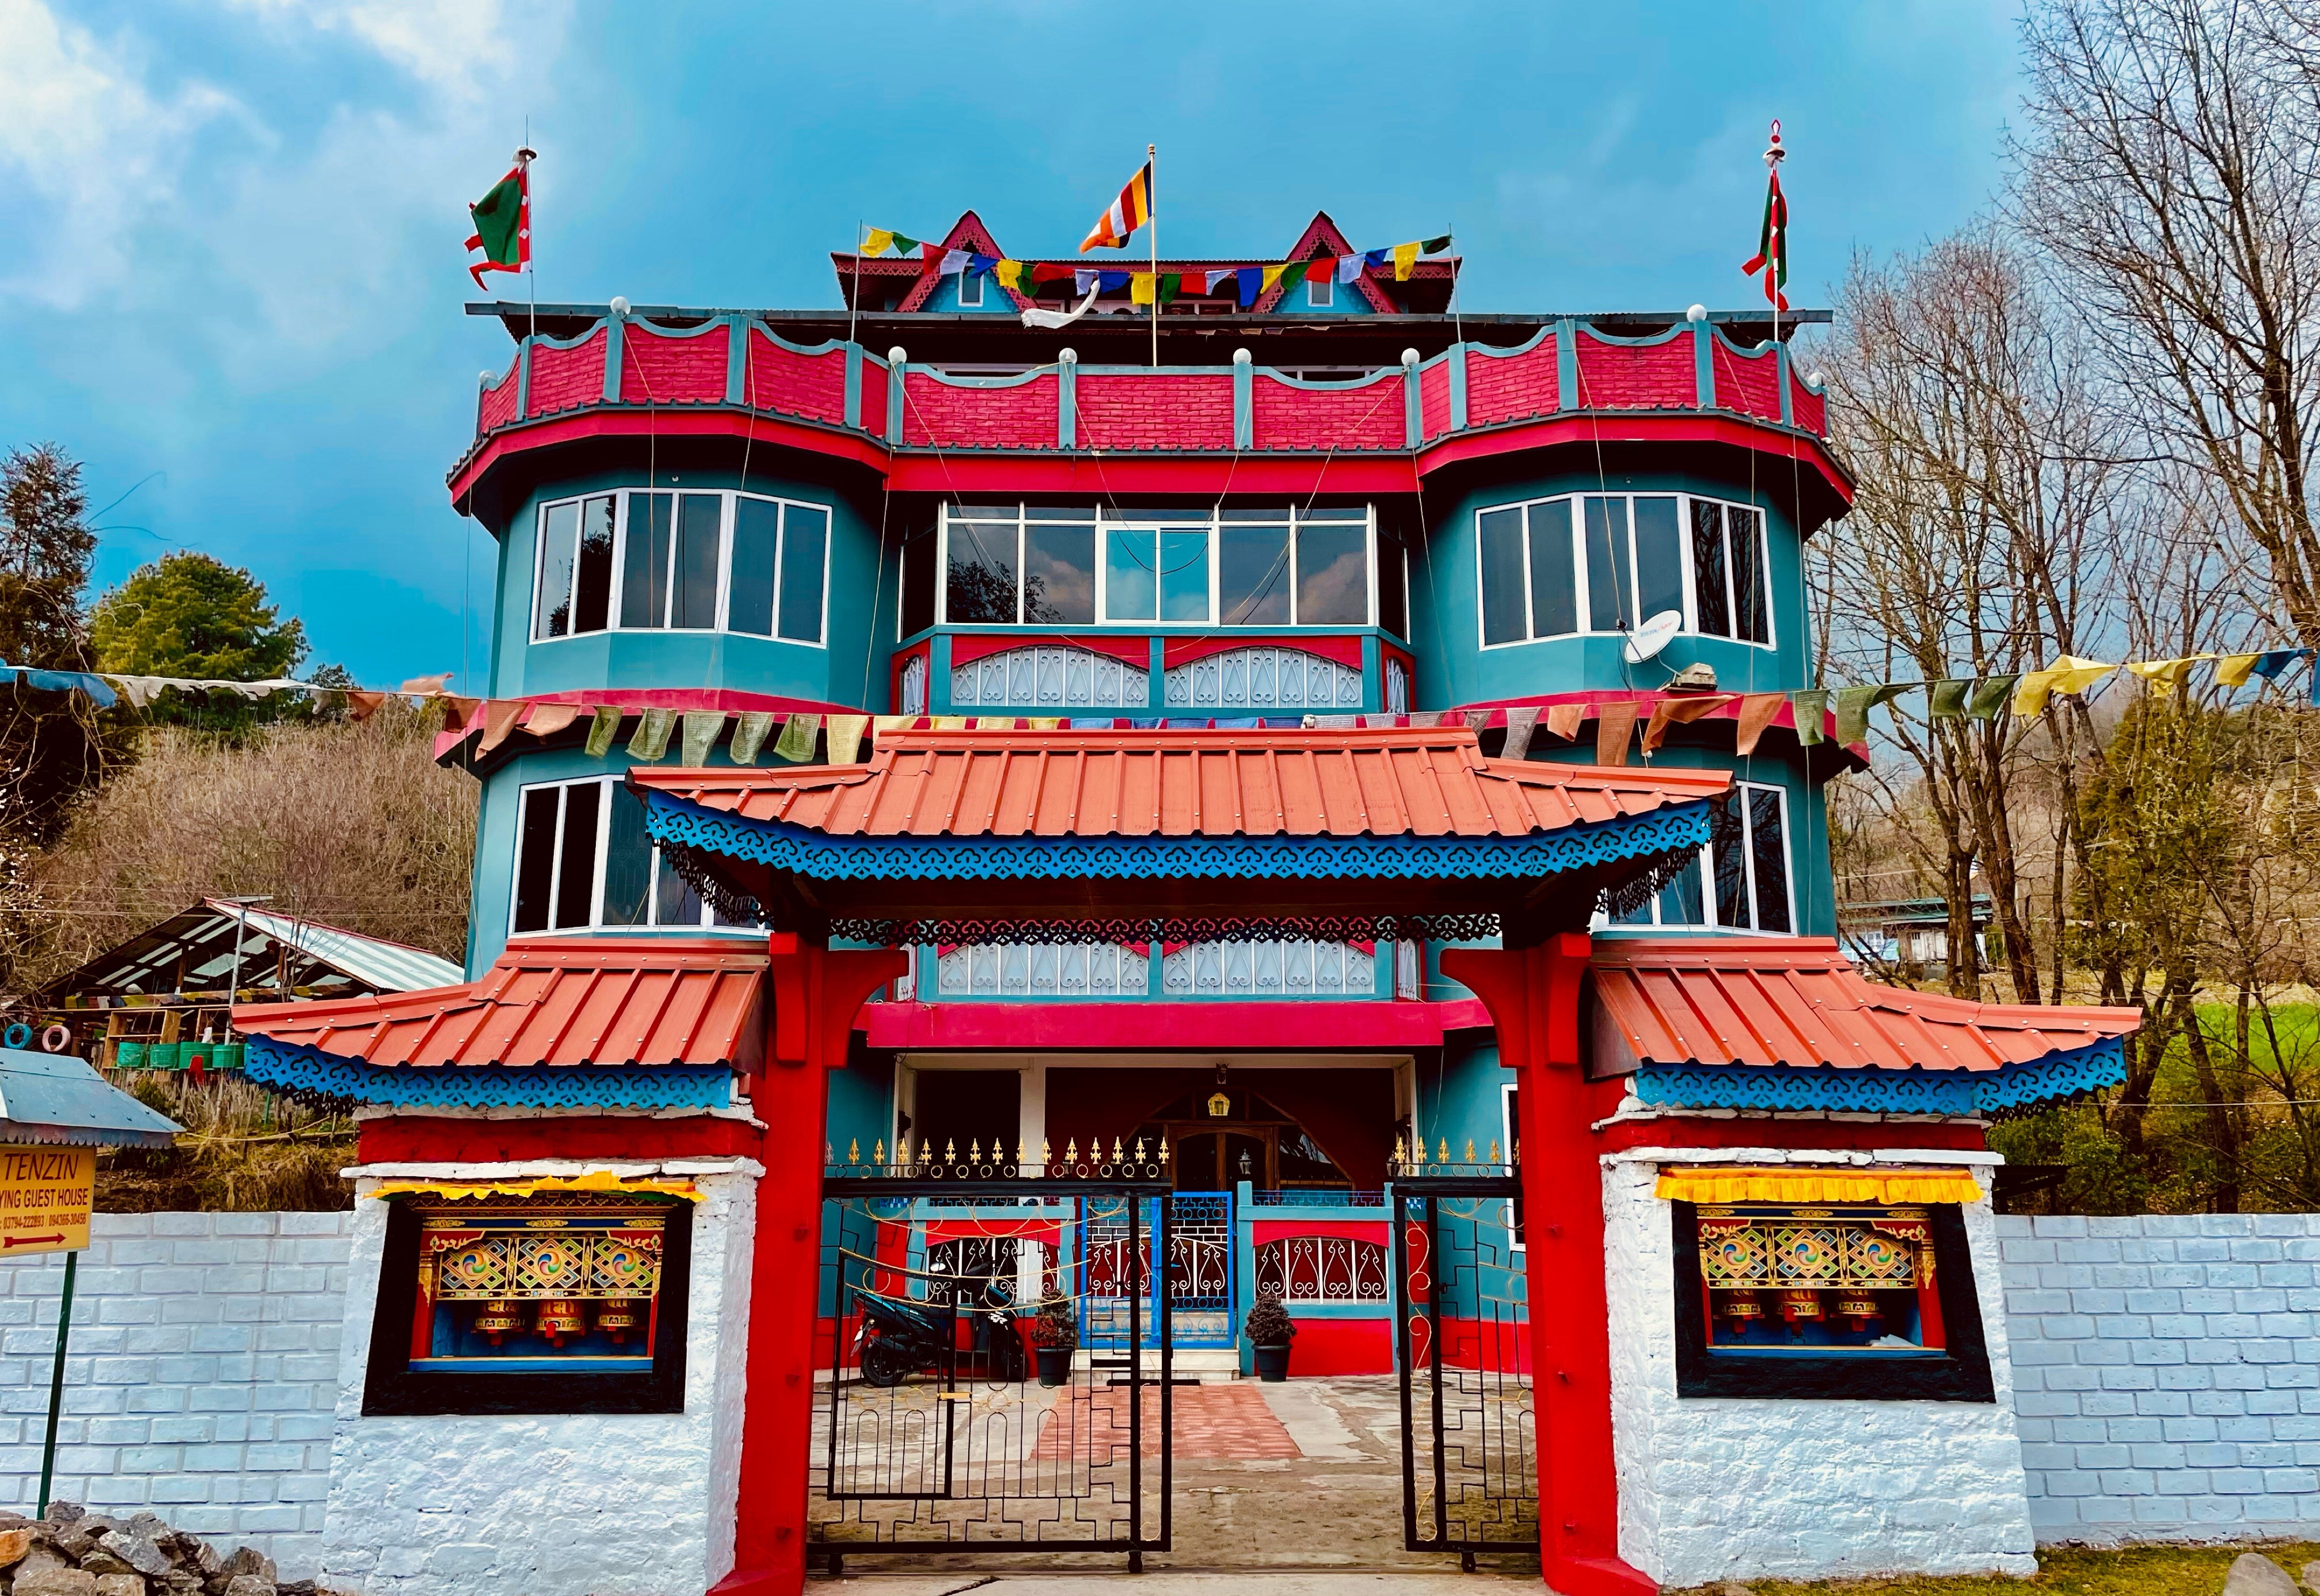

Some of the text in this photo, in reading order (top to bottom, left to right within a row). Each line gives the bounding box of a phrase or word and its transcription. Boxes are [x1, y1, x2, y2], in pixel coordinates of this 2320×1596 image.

[4, 1153, 79, 1181] TENZIN
[24, 1189, 56, 1208] GUEST
[57, 1188, 89, 1207] HOUSE
